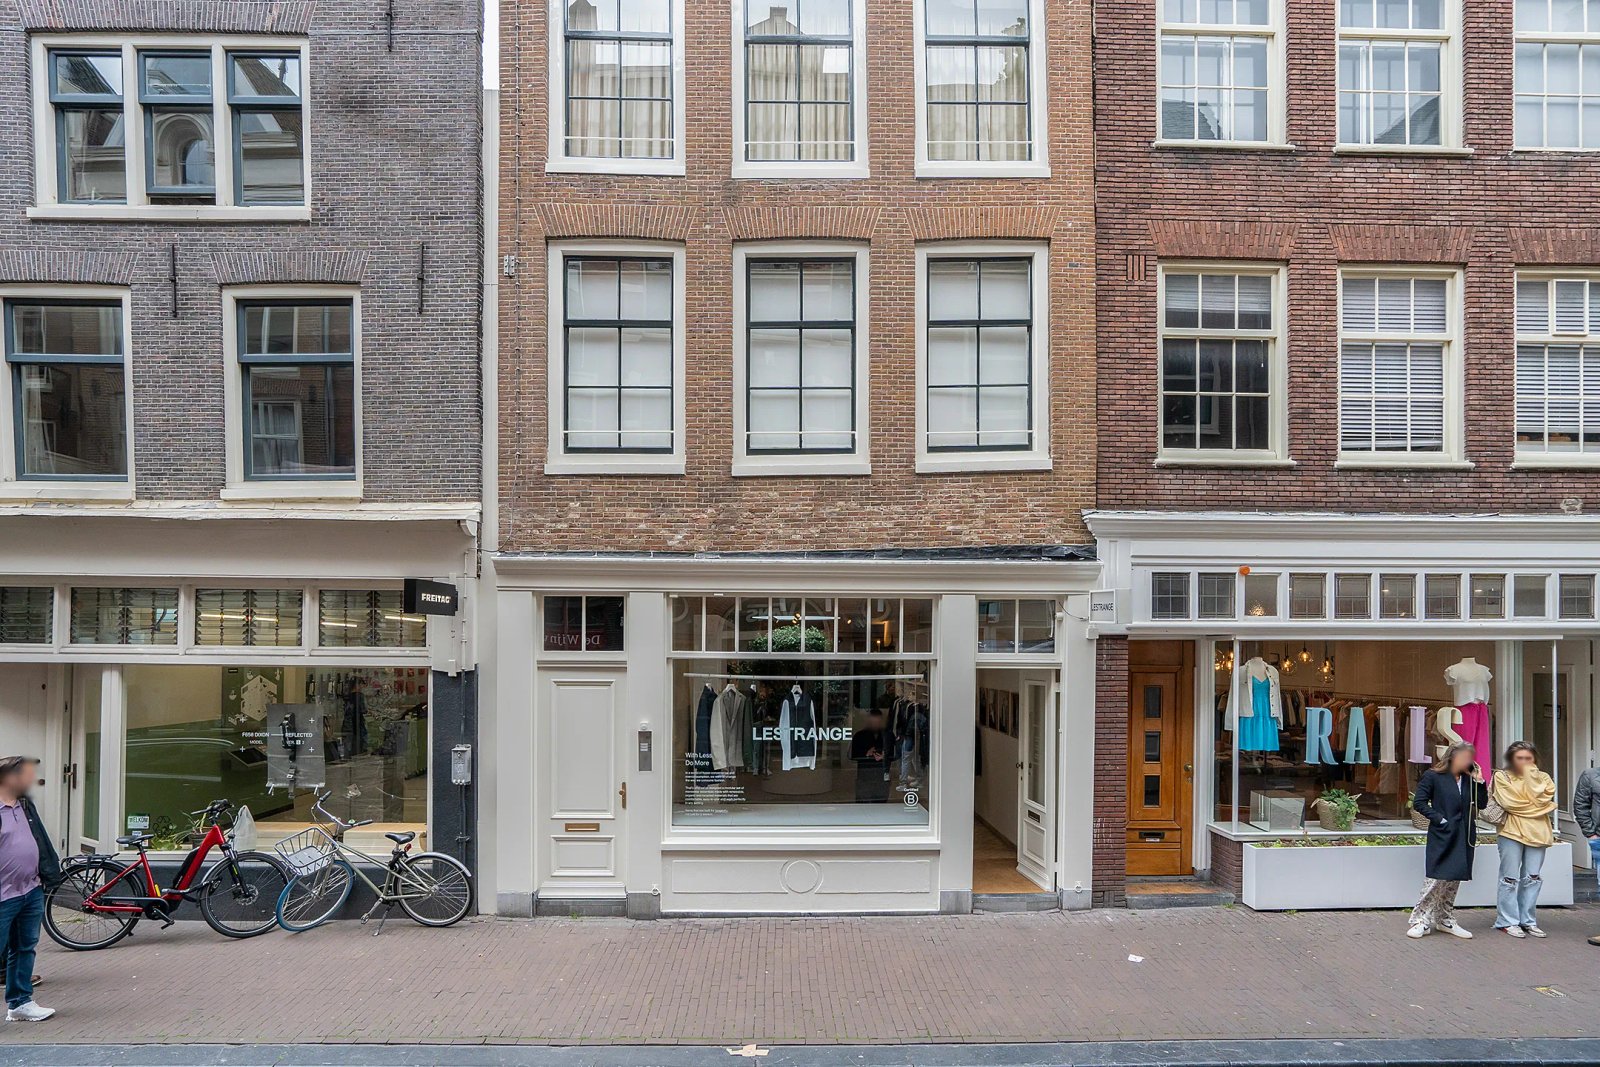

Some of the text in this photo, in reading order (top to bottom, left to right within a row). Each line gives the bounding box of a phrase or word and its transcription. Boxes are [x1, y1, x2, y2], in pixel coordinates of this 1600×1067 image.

[421, 593, 450, 603] FREITAG
[1090, 602, 1114, 612] LESTRANGE
[752, 727, 853, 741] LESTRANGE
[1304, 706, 1464, 765] RAILS
